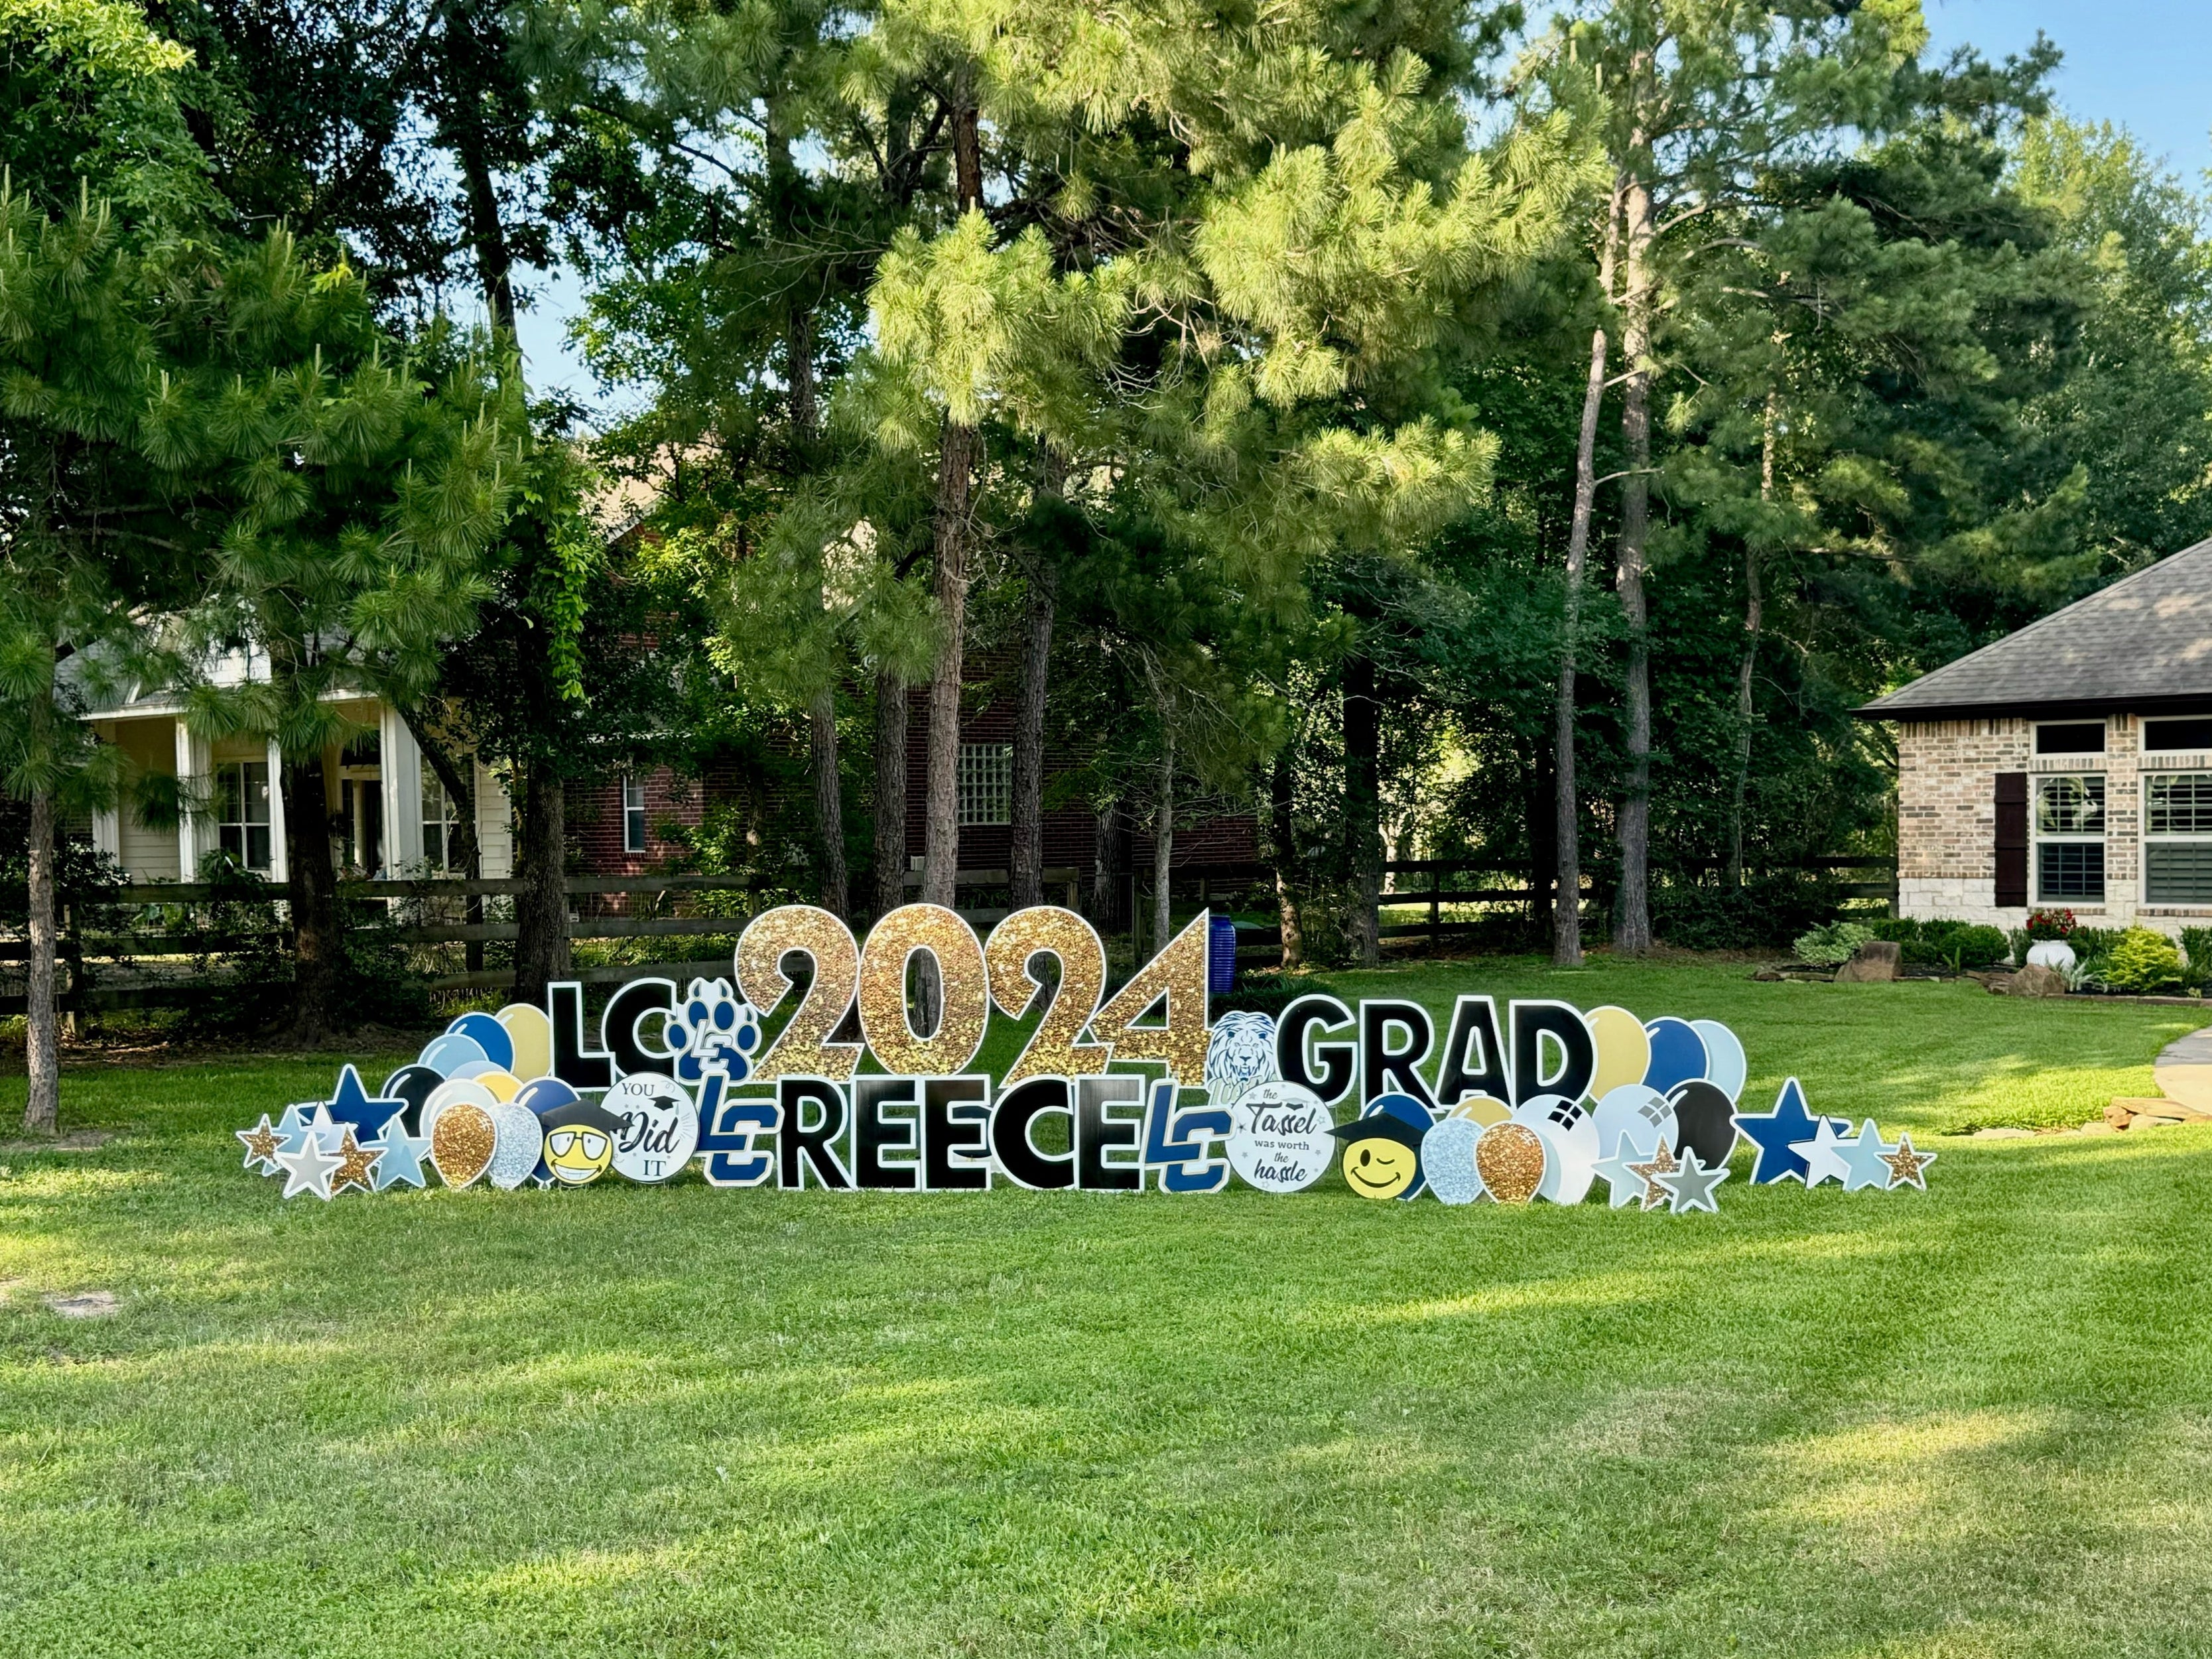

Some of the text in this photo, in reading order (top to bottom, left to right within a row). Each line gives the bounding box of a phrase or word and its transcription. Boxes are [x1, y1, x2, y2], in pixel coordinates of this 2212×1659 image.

[735, 903, 1210, 1089] 2024
[549, 977, 678, 1092] LC
[1274, 994, 1598, 1112] GRAD
[621, 1083, 655, 1096] YOU
[1263, 1089, 1278, 1100] the
[611, 1111, 681, 1154] Did
[777, 1074, 1147, 1192] REECE
[1246, 1102, 1317, 1136] Tassel
[1254, 1140, 1310, 1150] was worth
[1273, 1152, 1290, 1163] the
[642, 1160, 667, 1176] IT
[1254, 1158, 1308, 1183] hassle
